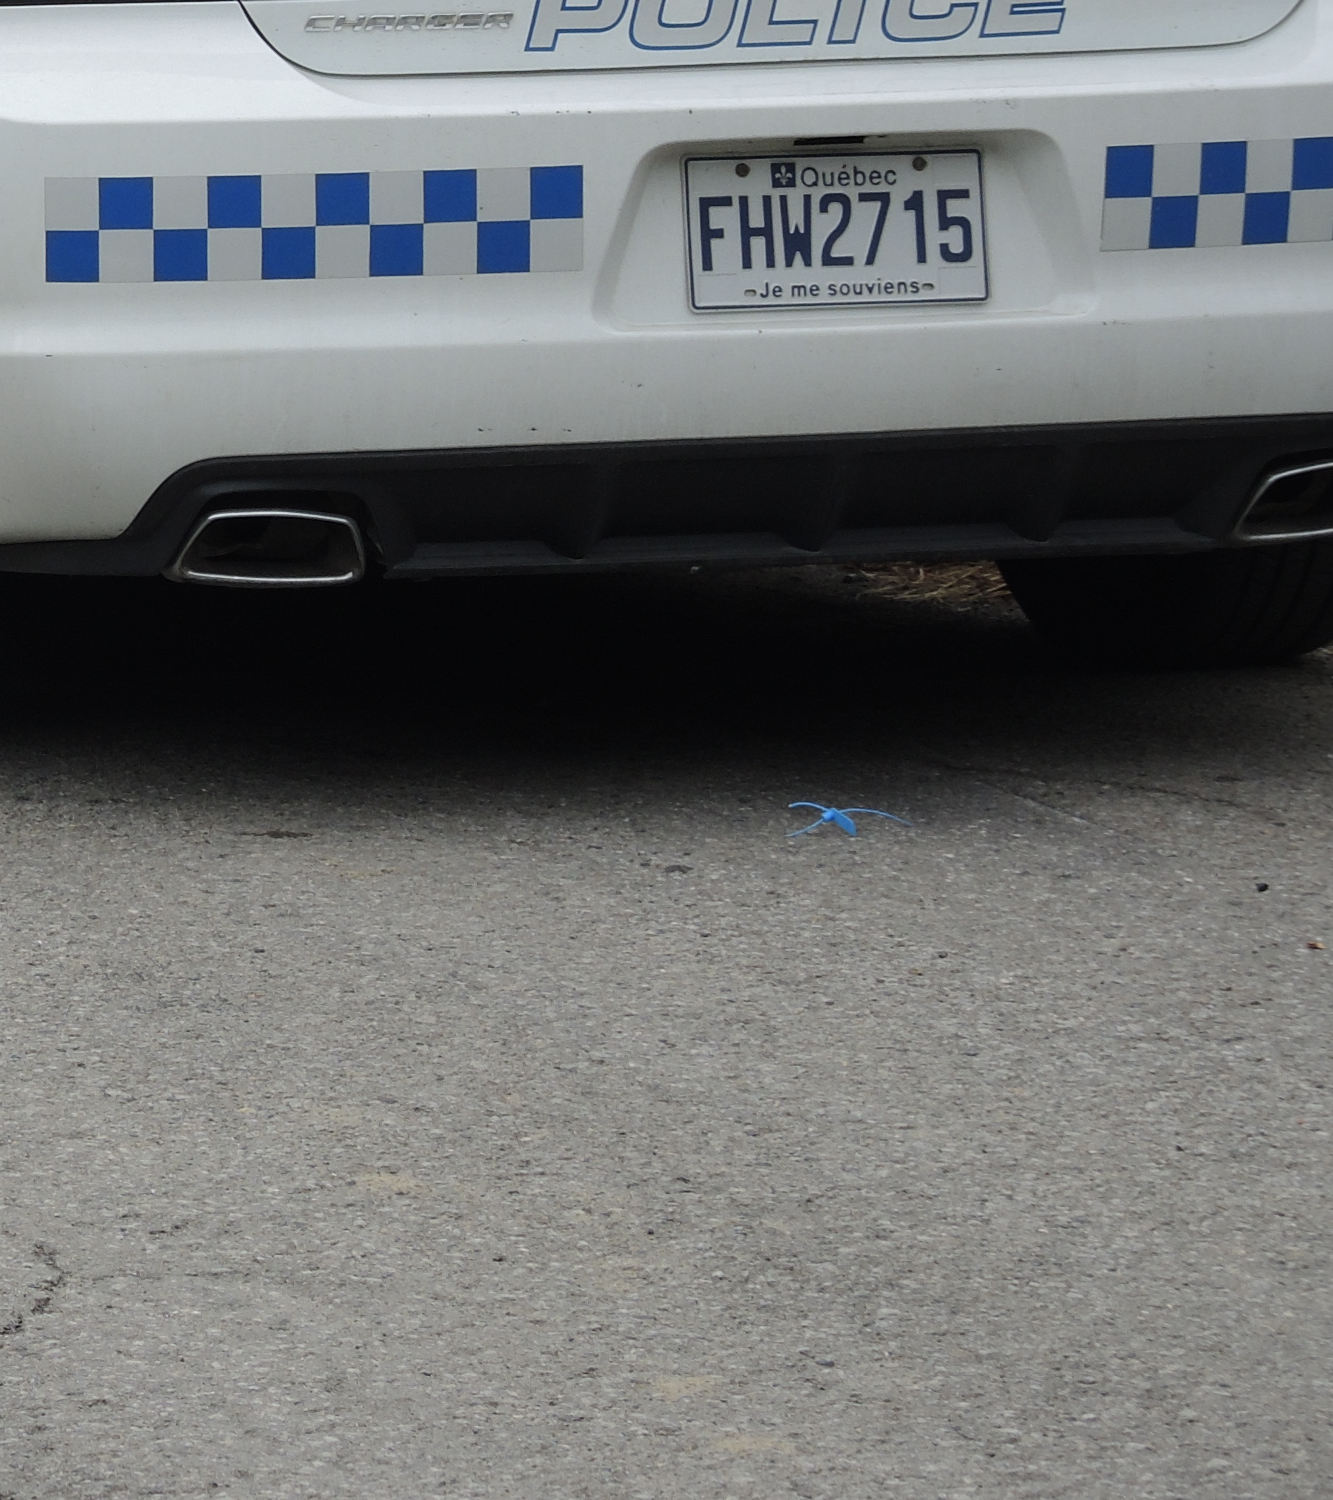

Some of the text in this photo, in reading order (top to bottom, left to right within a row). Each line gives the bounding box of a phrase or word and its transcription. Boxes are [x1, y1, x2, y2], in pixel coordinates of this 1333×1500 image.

[304, 10, 515, 33] CHARGER
[800, 164, 897, 188] Québec
[698, 188, 973, 272] FHW2715
[759, 278, 921, 298] Je me souviens
